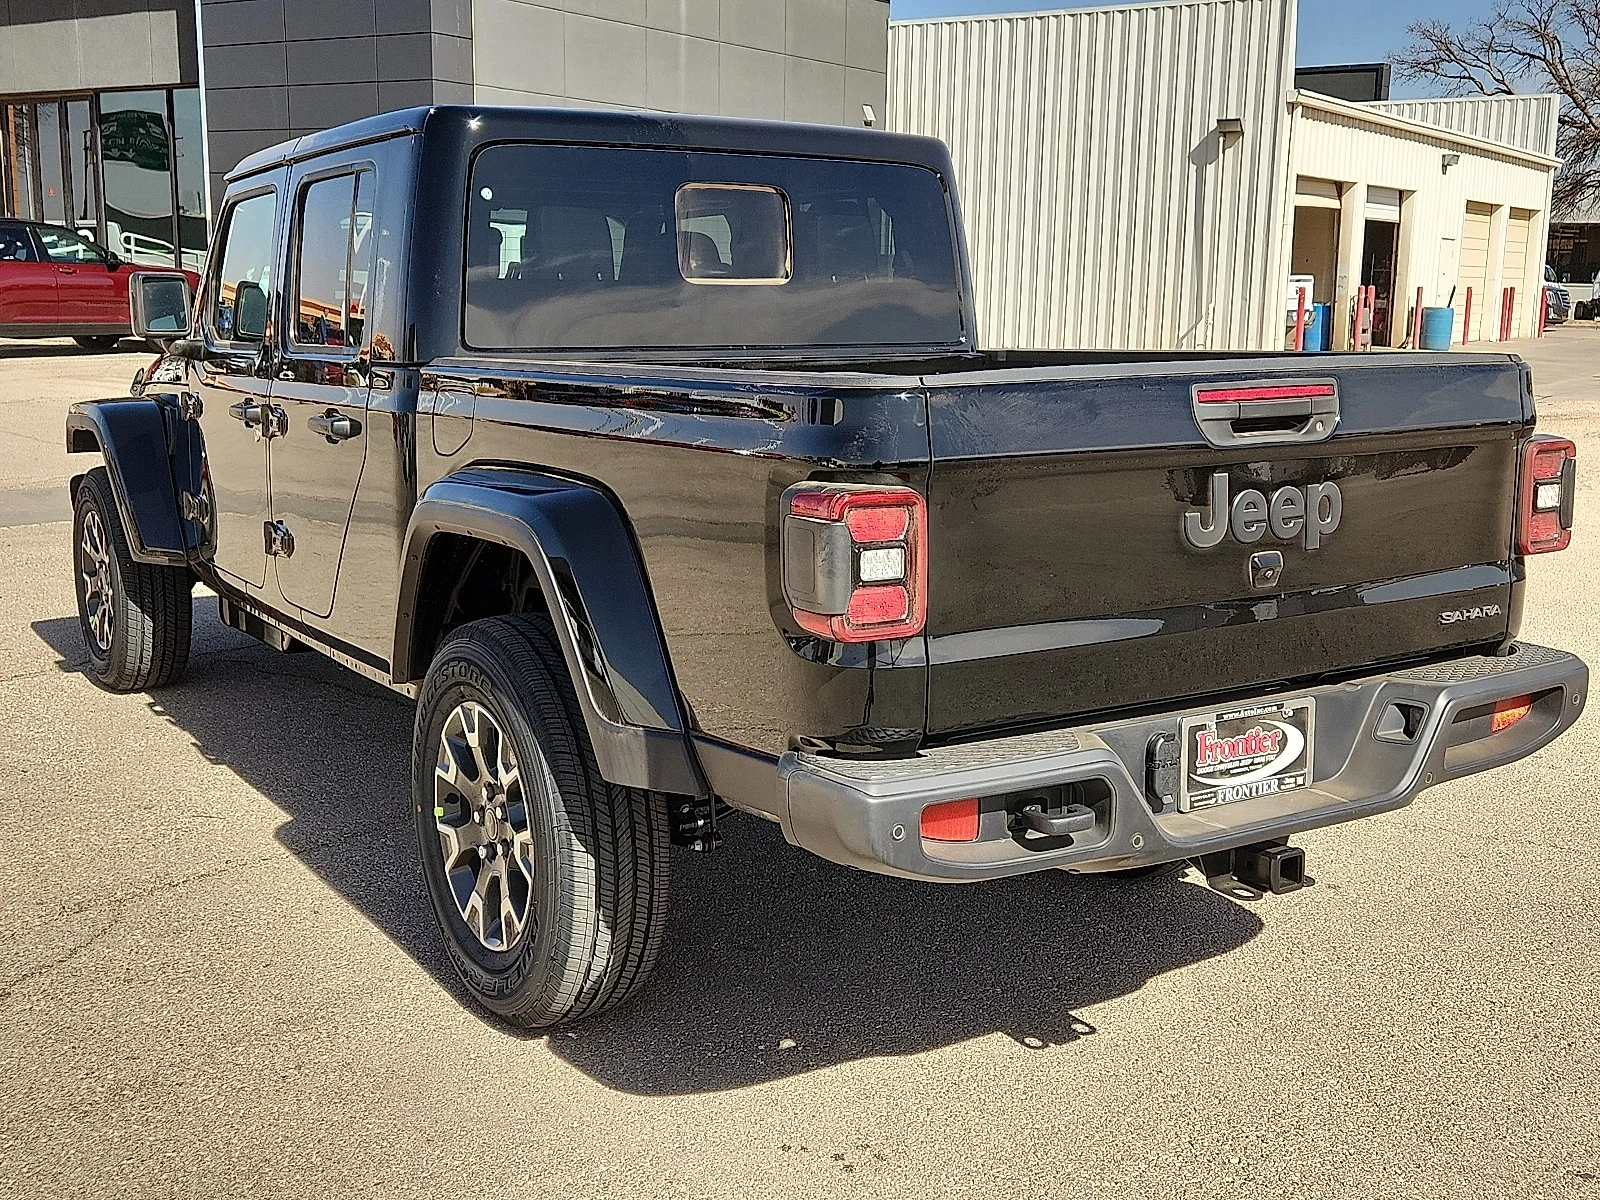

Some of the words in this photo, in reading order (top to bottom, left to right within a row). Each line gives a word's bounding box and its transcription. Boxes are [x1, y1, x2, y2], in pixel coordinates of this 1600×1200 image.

[1185, 473, 1342, 549] Jeep
[1438, 603, 1501, 624] SAHARA
[1197, 728, 1281, 765] Frontier
[1217, 778, 1279, 804] FRONTIER
